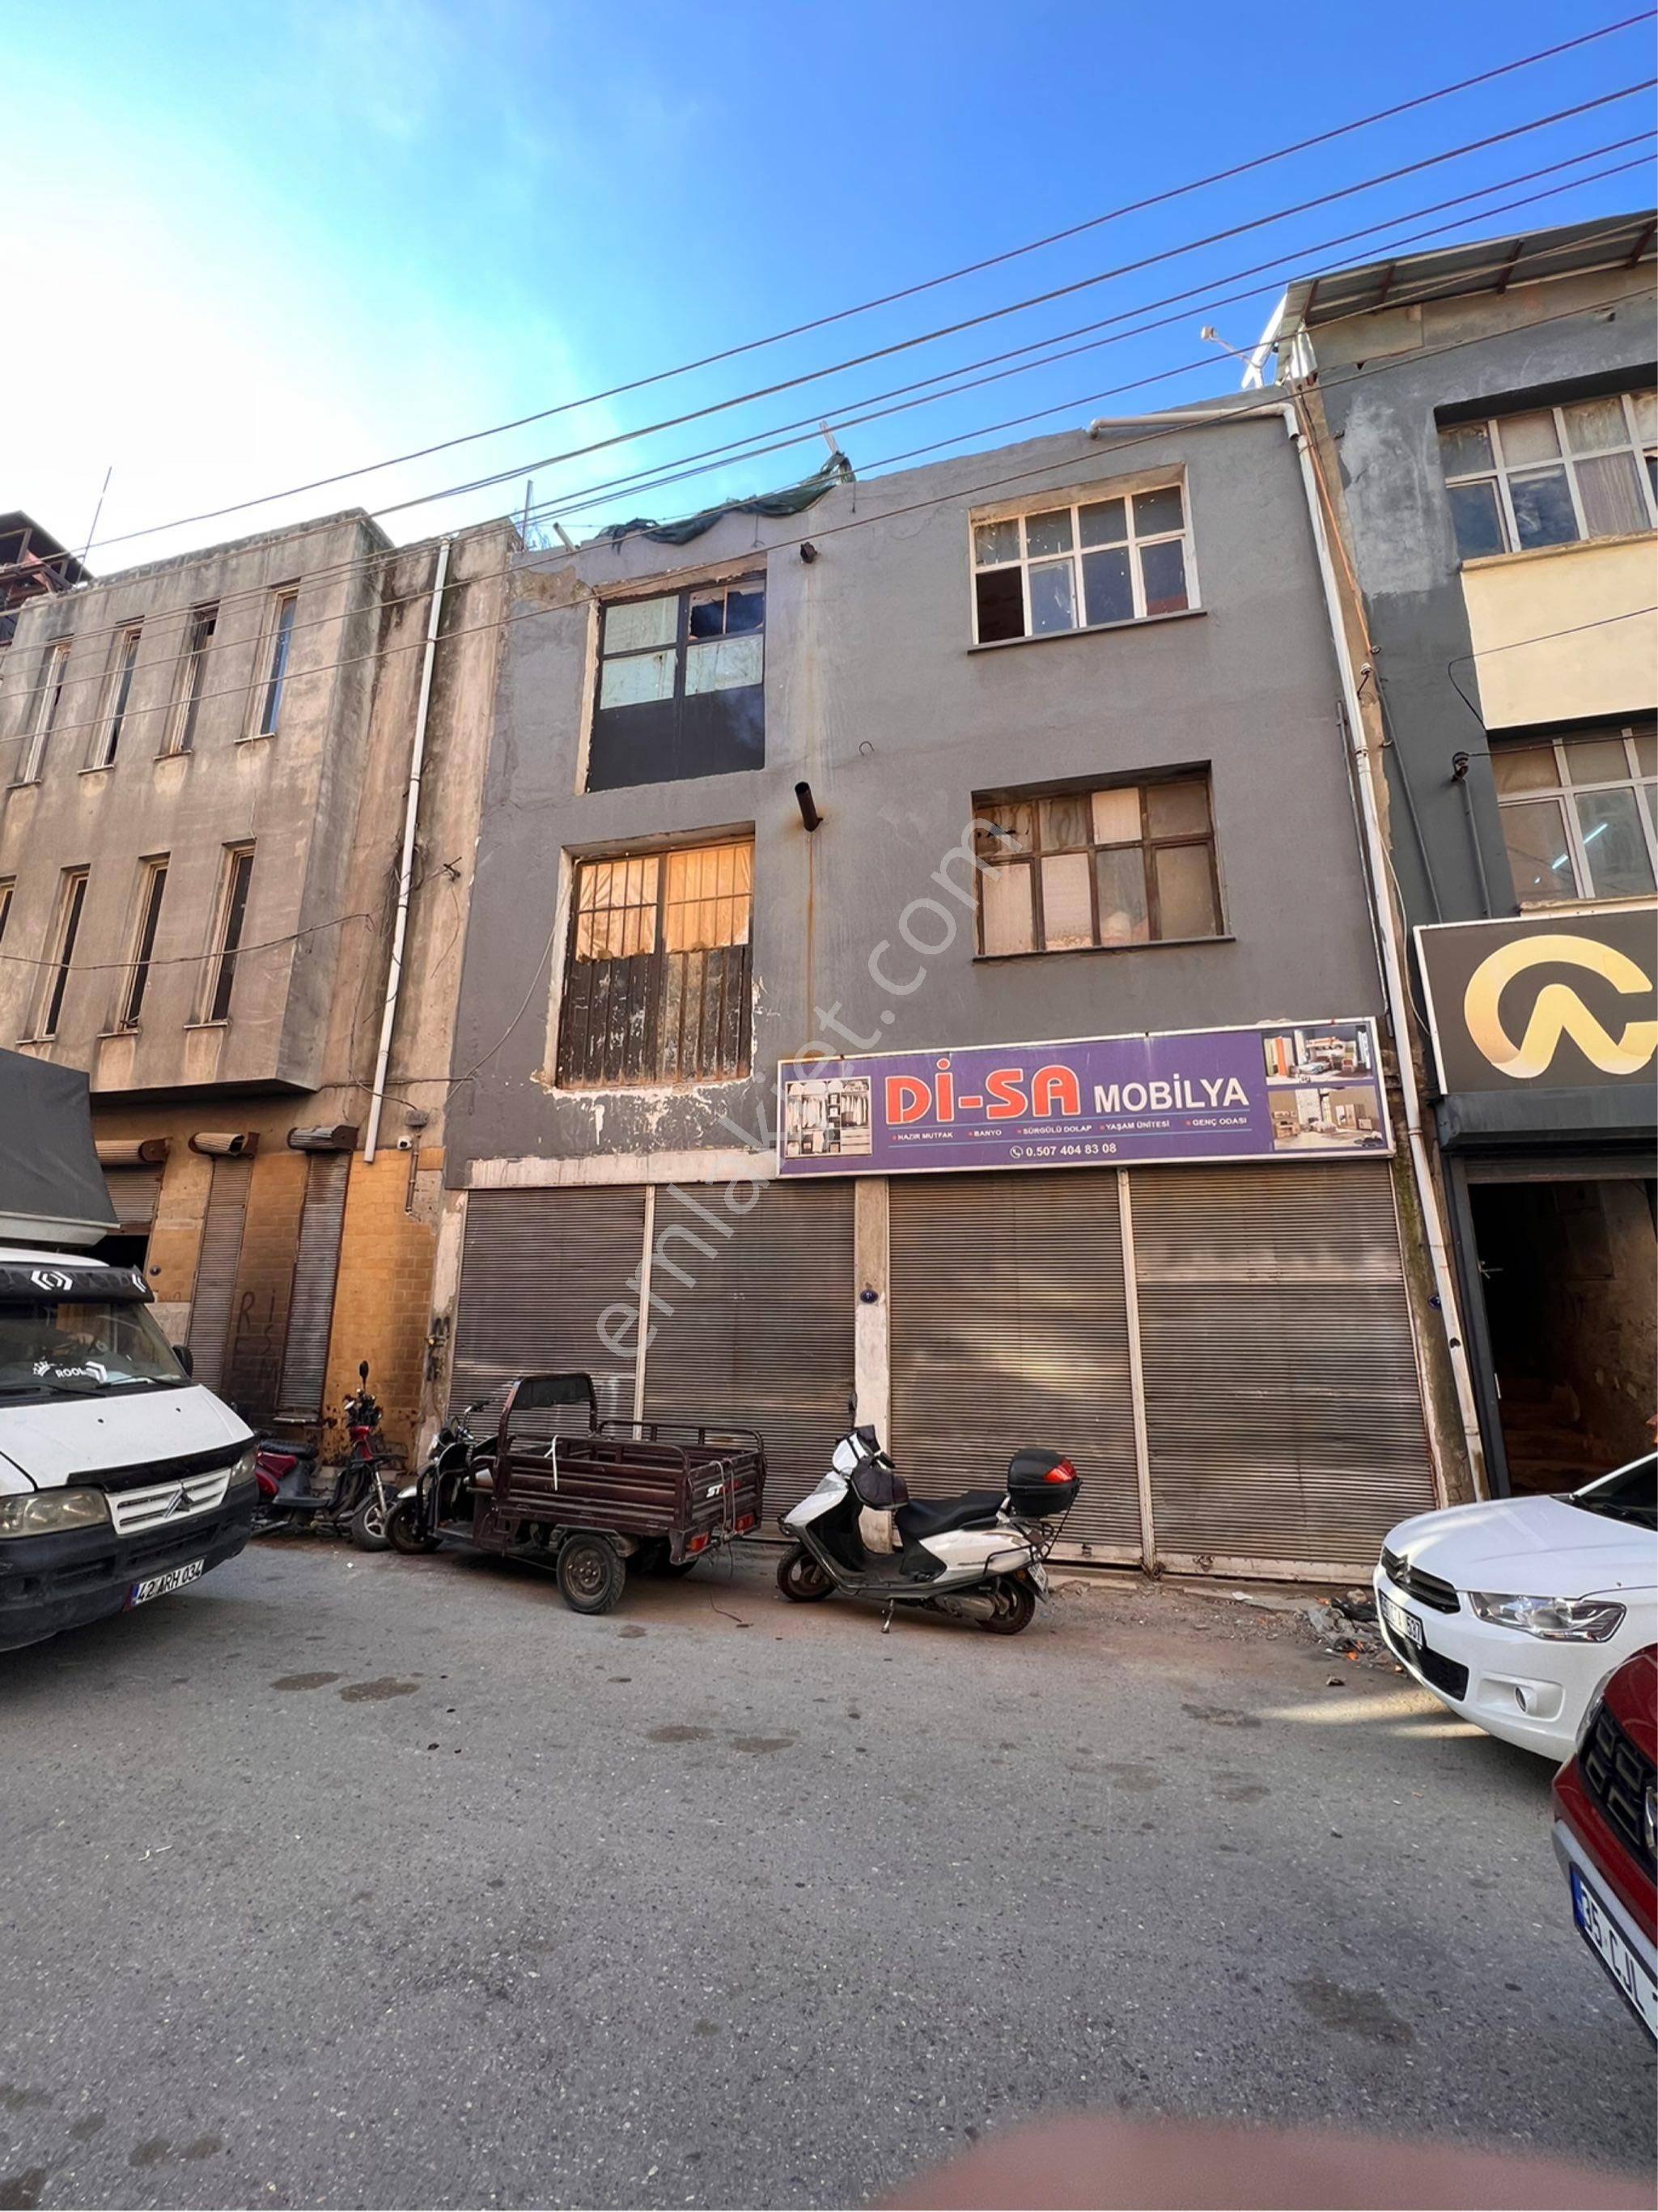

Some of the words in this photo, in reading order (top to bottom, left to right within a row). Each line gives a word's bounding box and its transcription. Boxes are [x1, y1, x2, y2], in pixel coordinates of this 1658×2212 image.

[885, 1058, 1081, 1125] Dİ-SA
[1094, 1073, 1250, 1113] MOBİLYA
[1105, 1121, 1134, 1131] YAŞAM
[1136, 1119, 1170, 1129] ÜNİTESİ
[1192, 1118, 1217, 1127] GENÇ
[1219, 1117, 1248, 1126] ODASI
[973, 1129, 1003, 1137] BANYO
[1023, 1125, 1062, 1135] SÜRGÜLÜ
[1063, 1124, 1092, 1133] DOLAP
[897, 1133, 921, 1141] HAZIR
[922, 1131, 953, 1140] MUTFAK
[1025, 1145, 1058, 1157] 0.507
[1059, 1144, 1082, 1156] 404
[1084, 1144, 1099, 1154] 83
[1102, 1142, 1117, 1153] 08
[138, 1581, 155, 1600] 42
[1581, 1887, 1603, 1948] 35
[1609, 1928, 1646, 2016] CJL
